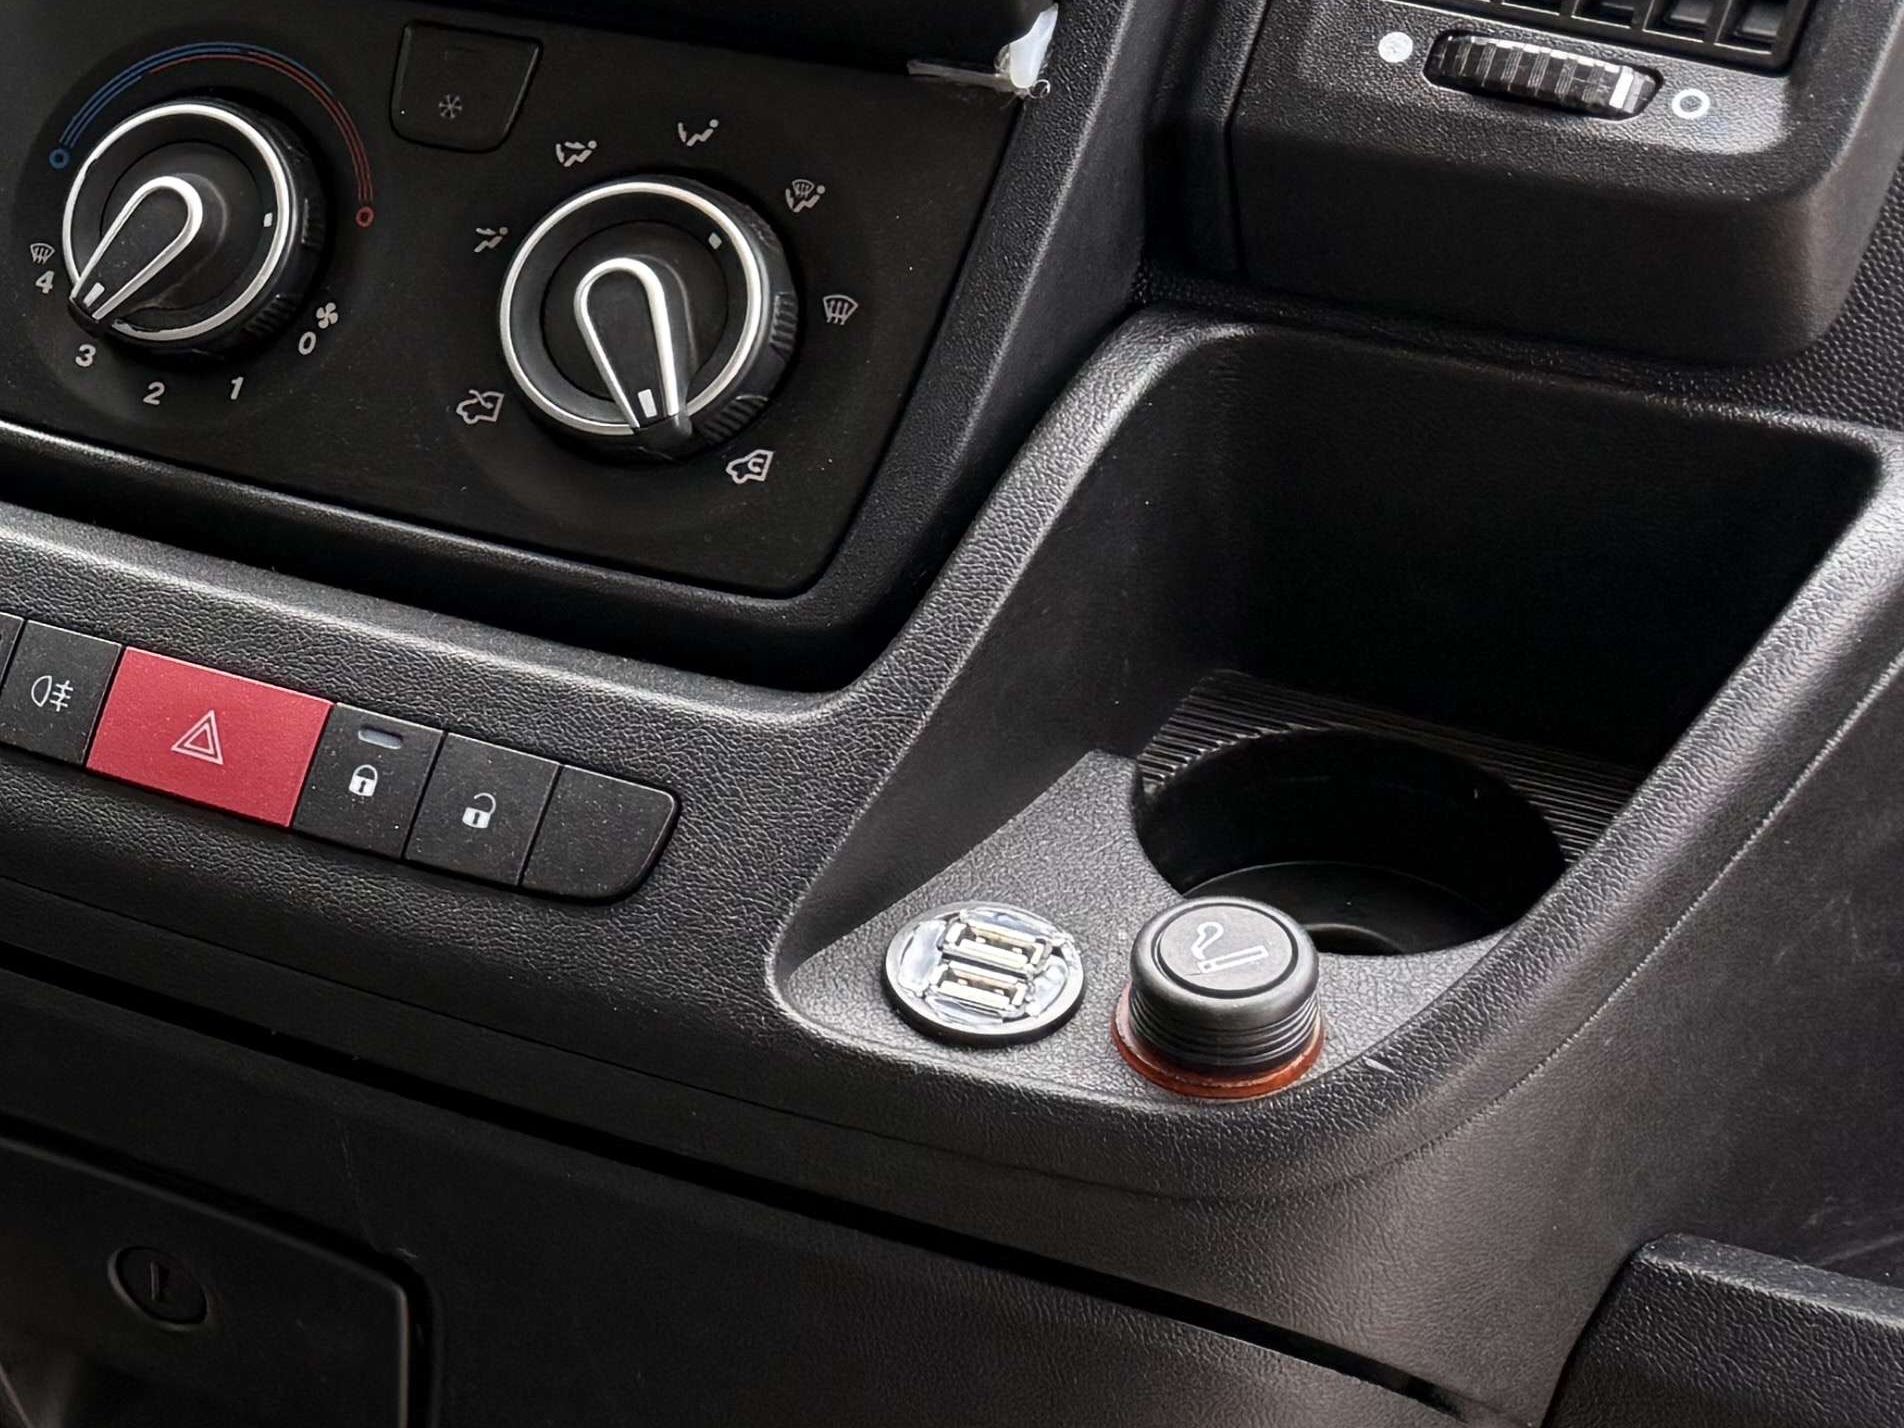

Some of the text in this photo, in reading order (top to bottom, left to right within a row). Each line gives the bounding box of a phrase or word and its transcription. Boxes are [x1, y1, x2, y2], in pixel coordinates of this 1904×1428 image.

[35, 270, 55, 295] 4
[75, 343, 97, 368] 3
[297, 330, 318, 357] 0
[142, 381, 166, 406] 2
[229, 375, 245, 401] 1
